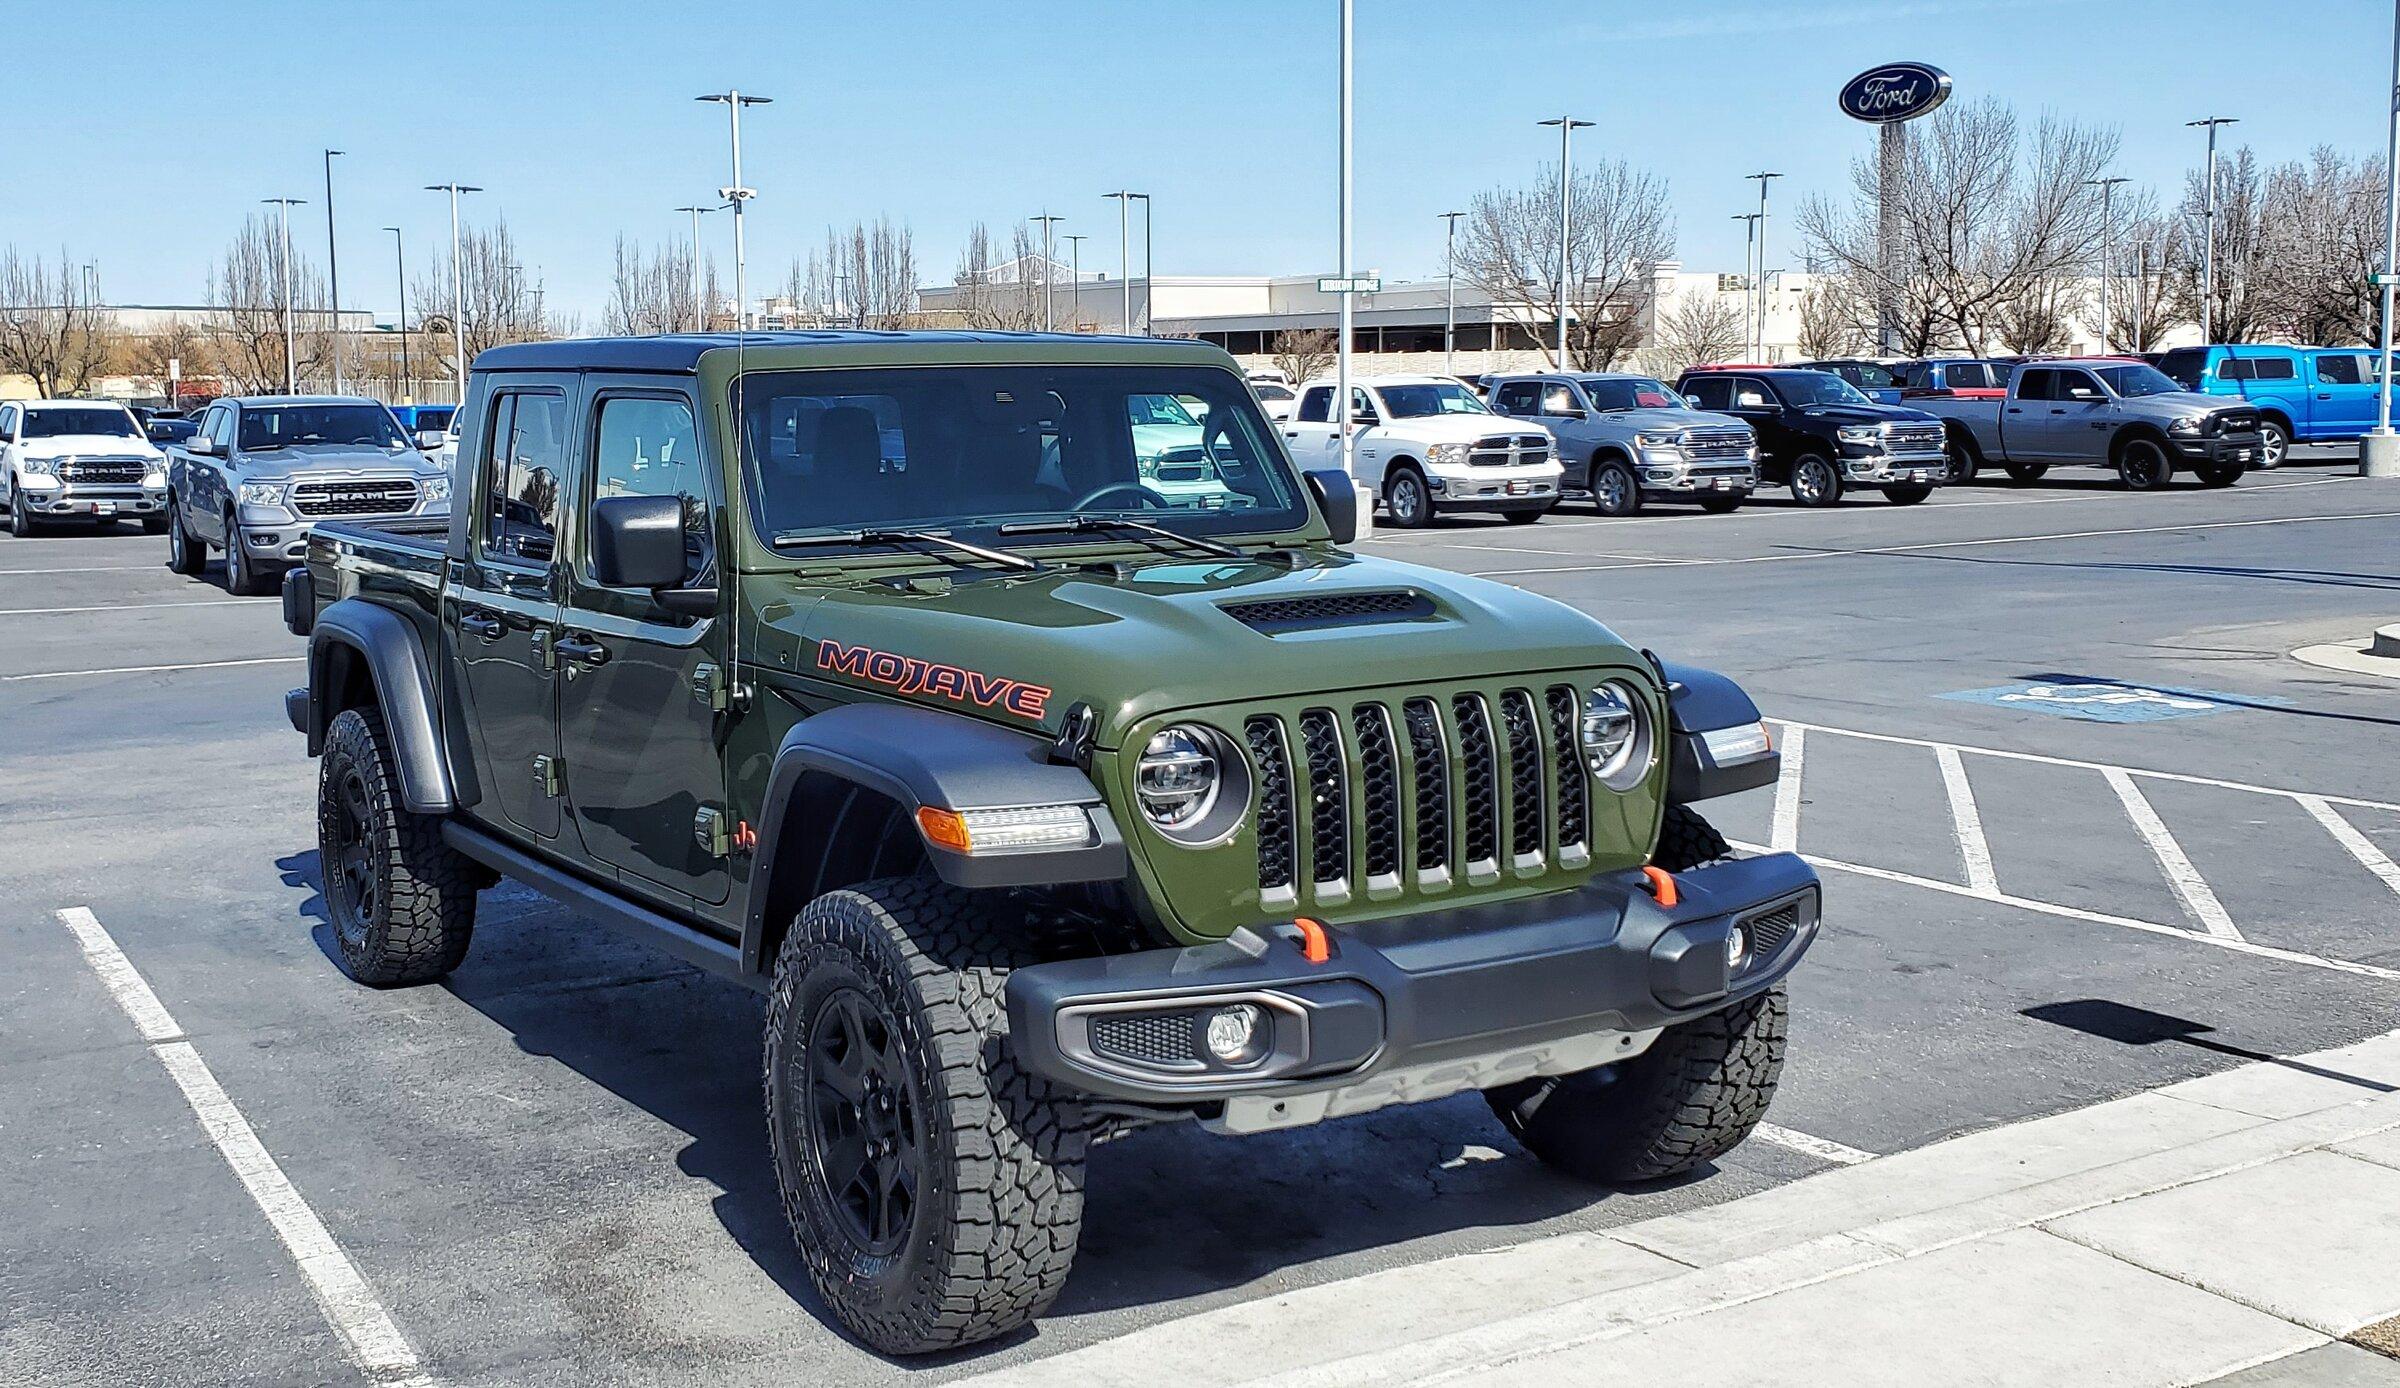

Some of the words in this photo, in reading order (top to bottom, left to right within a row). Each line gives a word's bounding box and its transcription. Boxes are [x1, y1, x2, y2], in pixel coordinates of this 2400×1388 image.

[1858, 75, 1918, 111] Ford
[332, 491, 383, 501] RAM
[817, 639, 1051, 720] MOJAVE
